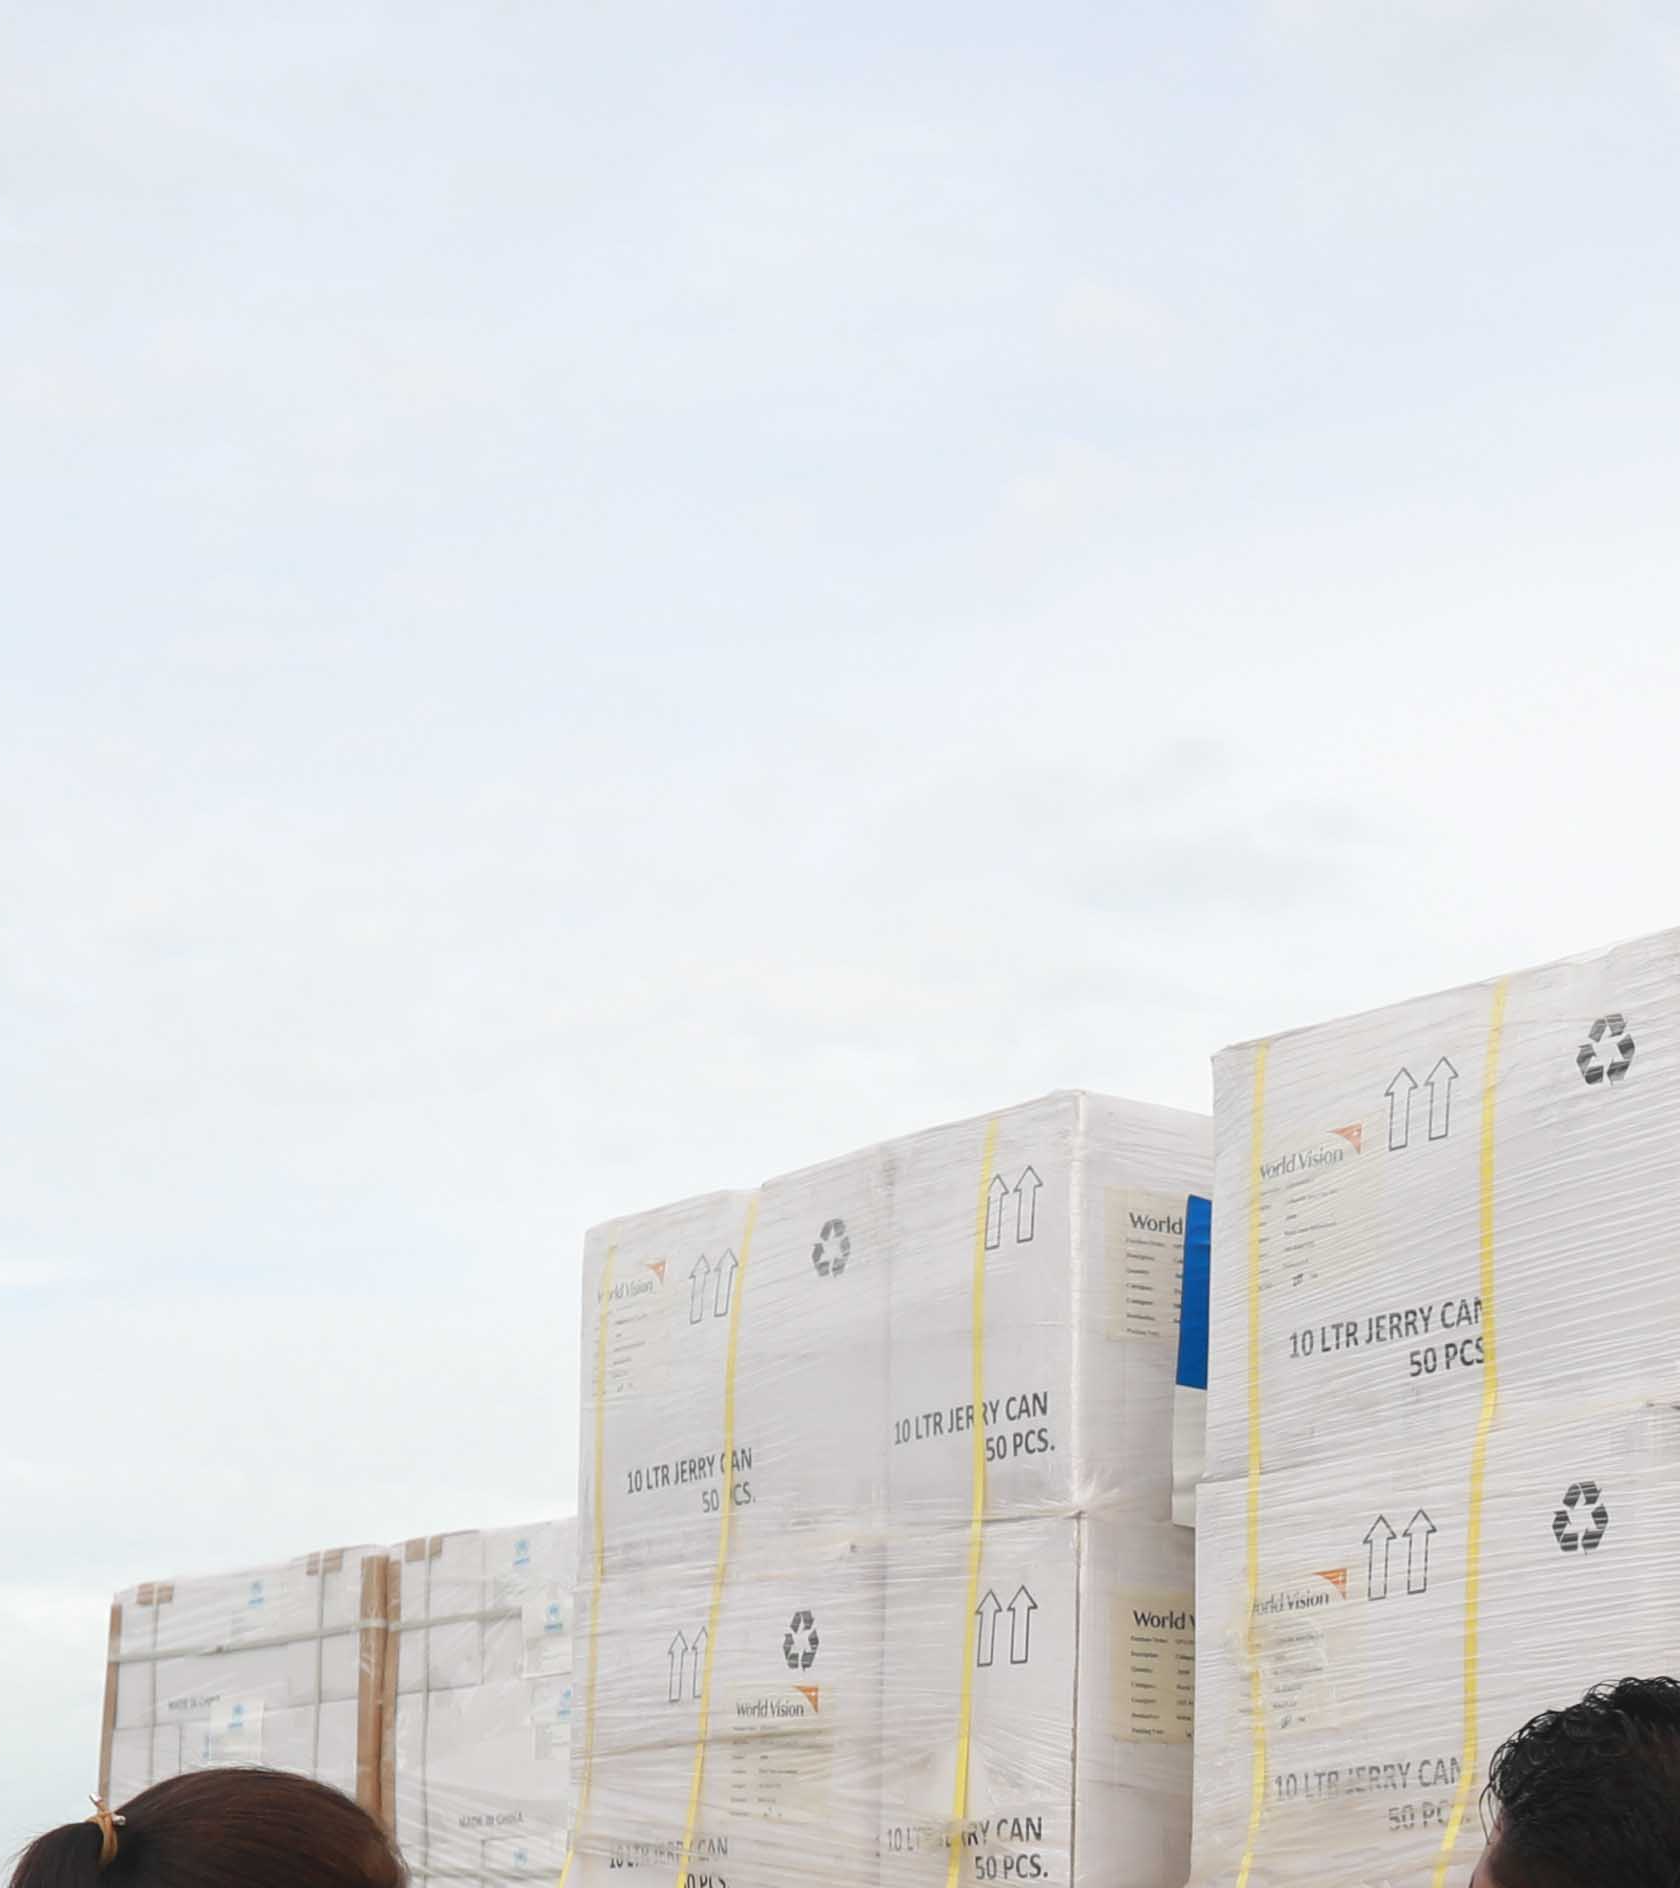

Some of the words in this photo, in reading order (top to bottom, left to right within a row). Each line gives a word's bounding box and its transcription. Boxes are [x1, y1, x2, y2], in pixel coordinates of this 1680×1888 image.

[1299, 1144, 1343, 1171] Vision
[1129, 1212, 1182, 1235] World
[1289, 1330, 1313, 1358] 10
[1321, 1321, 1359, 1352] LTR
[1365, 1305, 1432, 1344] JERRY
[1409, 1348, 1438, 1377] 50
[895, 1419, 910, 1443] 10
[915, 1412, 943, 1439] LTR
[1006, 1391, 1048, 1422] CAN
[985, 1435, 1007, 1461] 50
[1013, 1429, 1055, 1456] PCS.
[627, 1469, 642, 1493] 10
[646, 1465, 670, 1489] LTR
[673, 1454, 715, 1484] JERRY
[1132, 1609, 1186, 1630] World
[735, 1701, 768, 1718] World
[770, 1700, 804, 1717] Vision
[996, 1816, 1042, 1842] CAN
[975, 1855, 997, 1880] 50
[1002, 1853, 1048, 1878] PCS.
